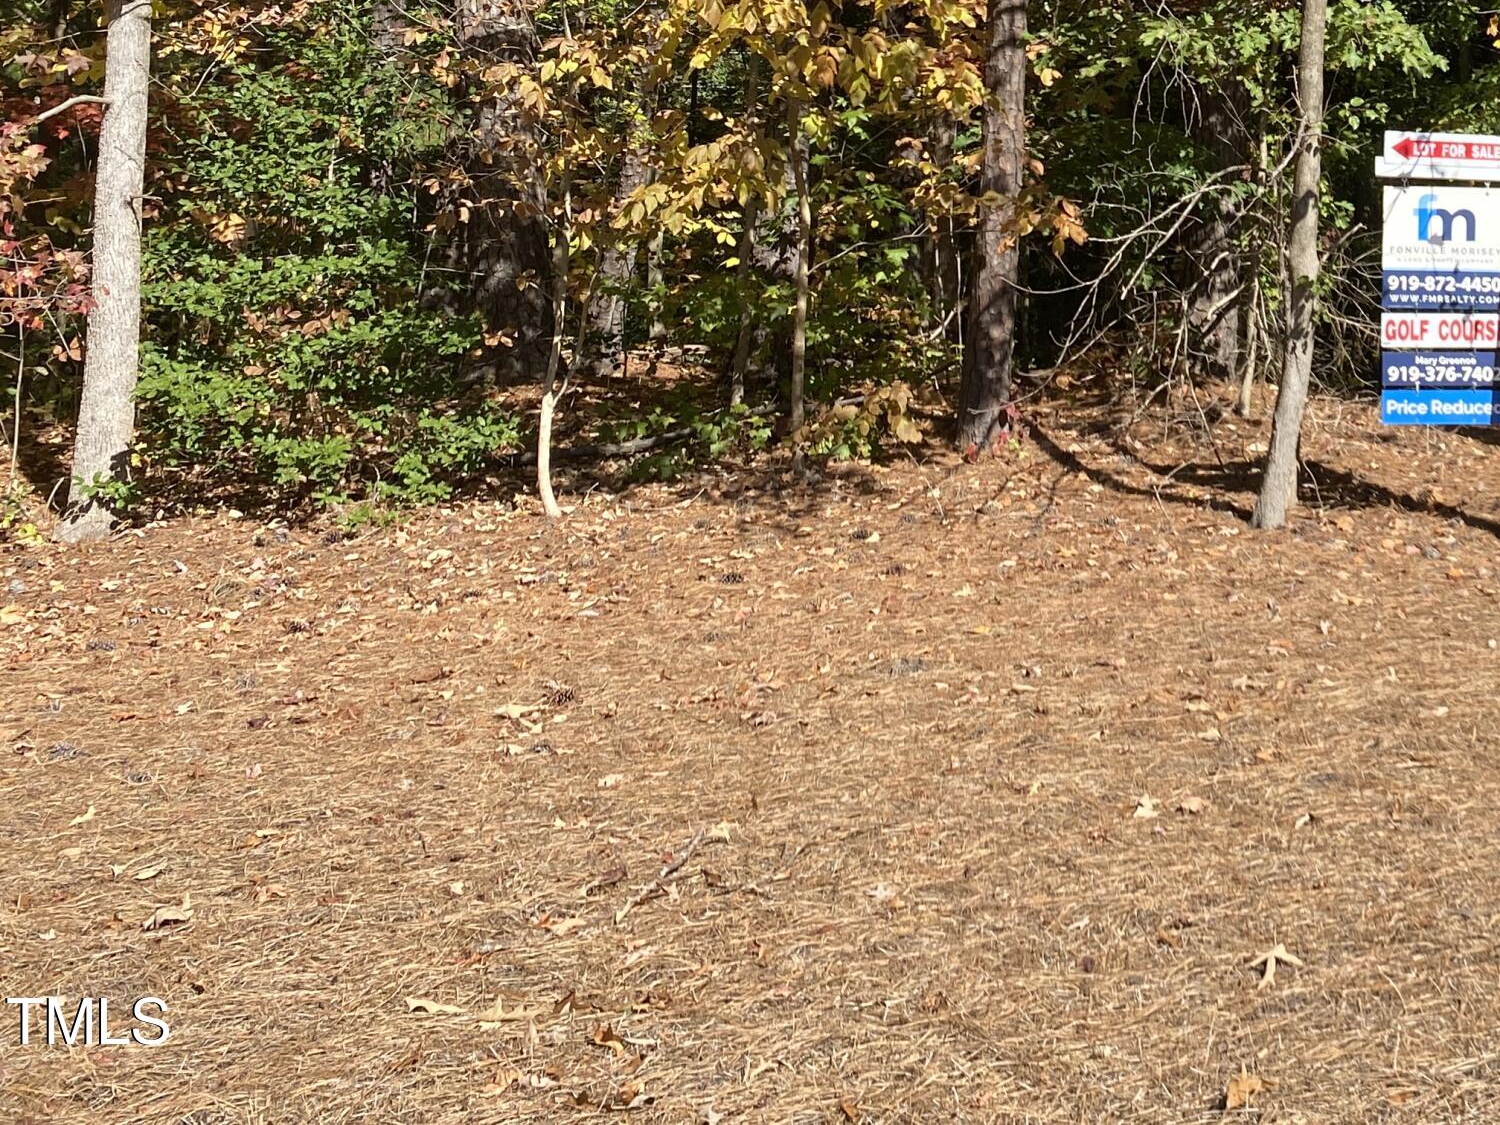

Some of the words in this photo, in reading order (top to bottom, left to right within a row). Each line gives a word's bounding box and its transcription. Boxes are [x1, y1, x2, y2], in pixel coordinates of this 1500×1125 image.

[1413, 142, 1436, 156] LOT
[1442, 144, 1465, 157] FOR
[1413, 194, 1476, 241] fm
[1390, 246, 1446, 255] FONVILLE
[1451, 248, 1500, 256] MORISEY
[1387, 275, 1500, 292] 919-872-4450
[1389, 294, 1500, 304] WWW.FMREALTY.COM
[1385, 319, 1429, 341] GOLF
[1415, 356, 1437, 366] Mary
[1386, 399, 1428, 414] Price
